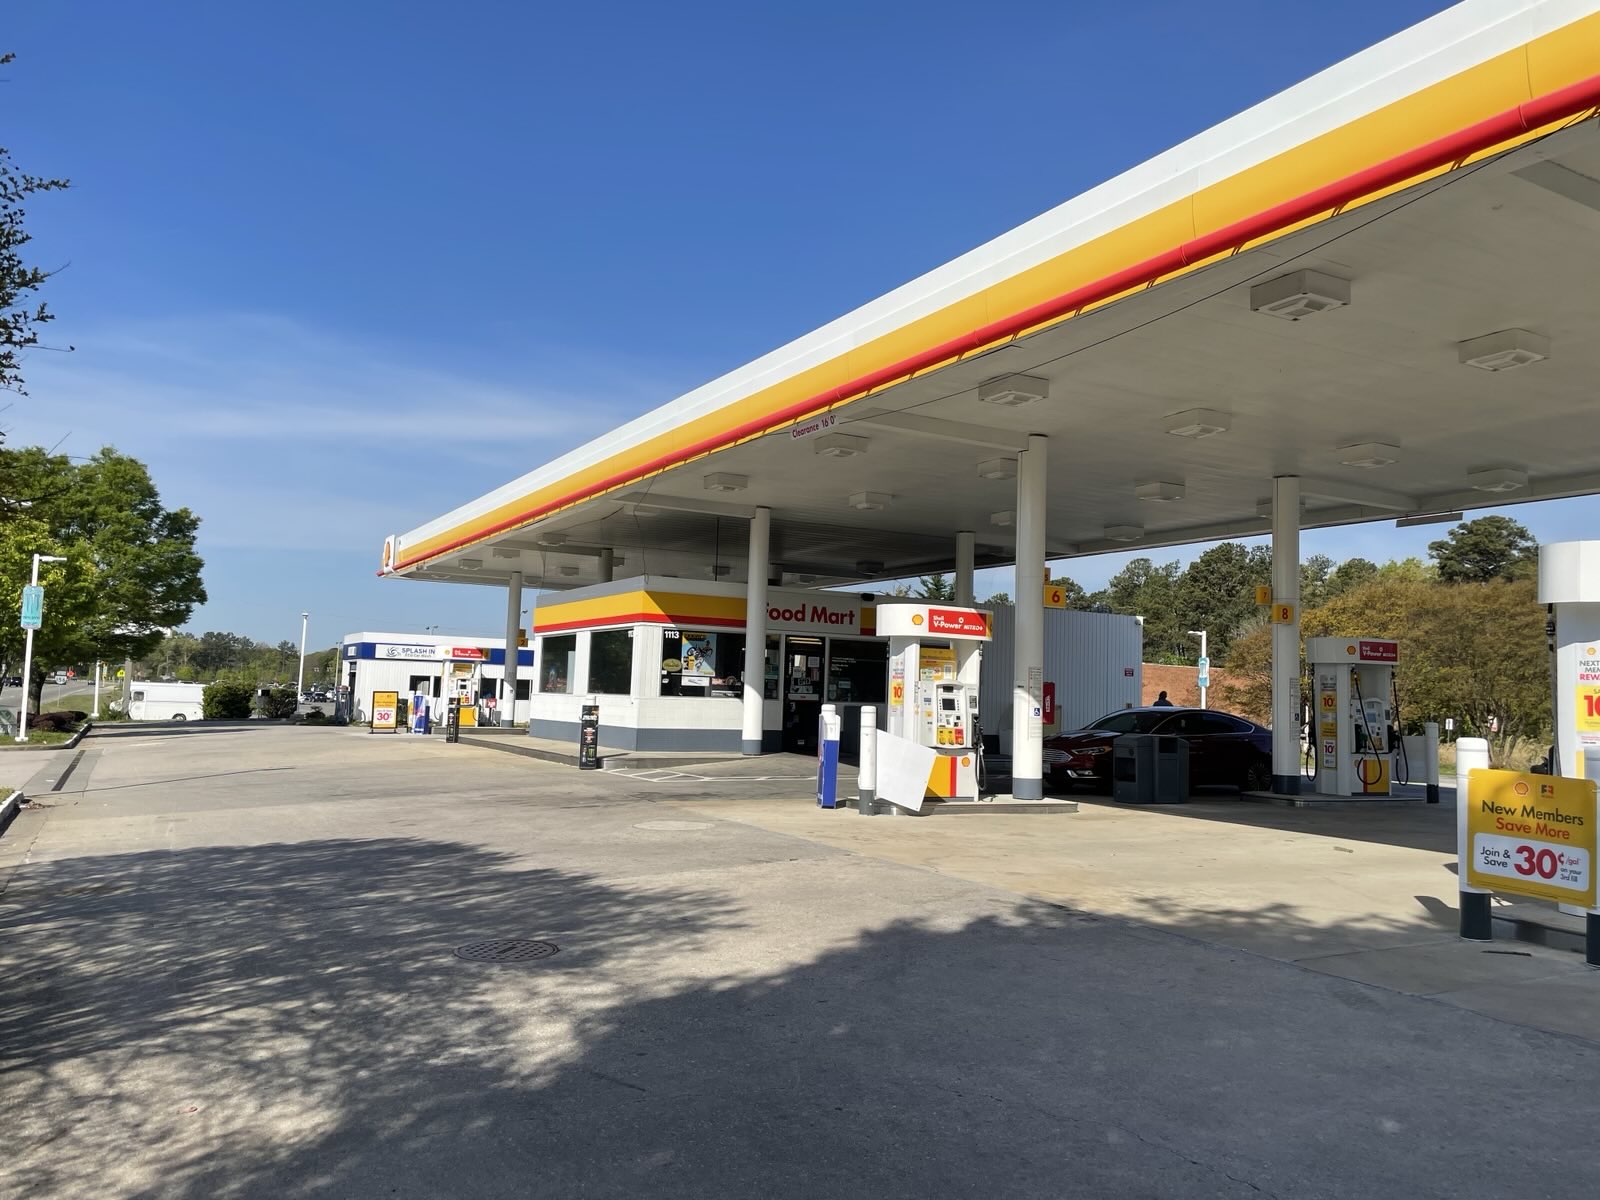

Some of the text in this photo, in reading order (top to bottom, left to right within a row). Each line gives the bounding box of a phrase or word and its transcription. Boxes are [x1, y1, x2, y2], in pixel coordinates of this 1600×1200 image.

[792, 423, 819, 438] Clearance
[1052, 590, 1060, 603] 6
[766, 603, 855, 625] ood Mart
[1282, 607, 1289, 620] 8
[933, 620, 961, 630] V-Power
[664, 630, 680, 639] 1113
[1579, 673, 1600, 681] REW
[1481, 799, 1584, 826] New Members
[1495, 817, 1570, 840] Save More
[1480, 846, 1511, 859] Join &
[1483, 856, 1508, 869] Save
[1560, 873, 1570, 881] 3rd
[1569, 868, 1582, 876] your
